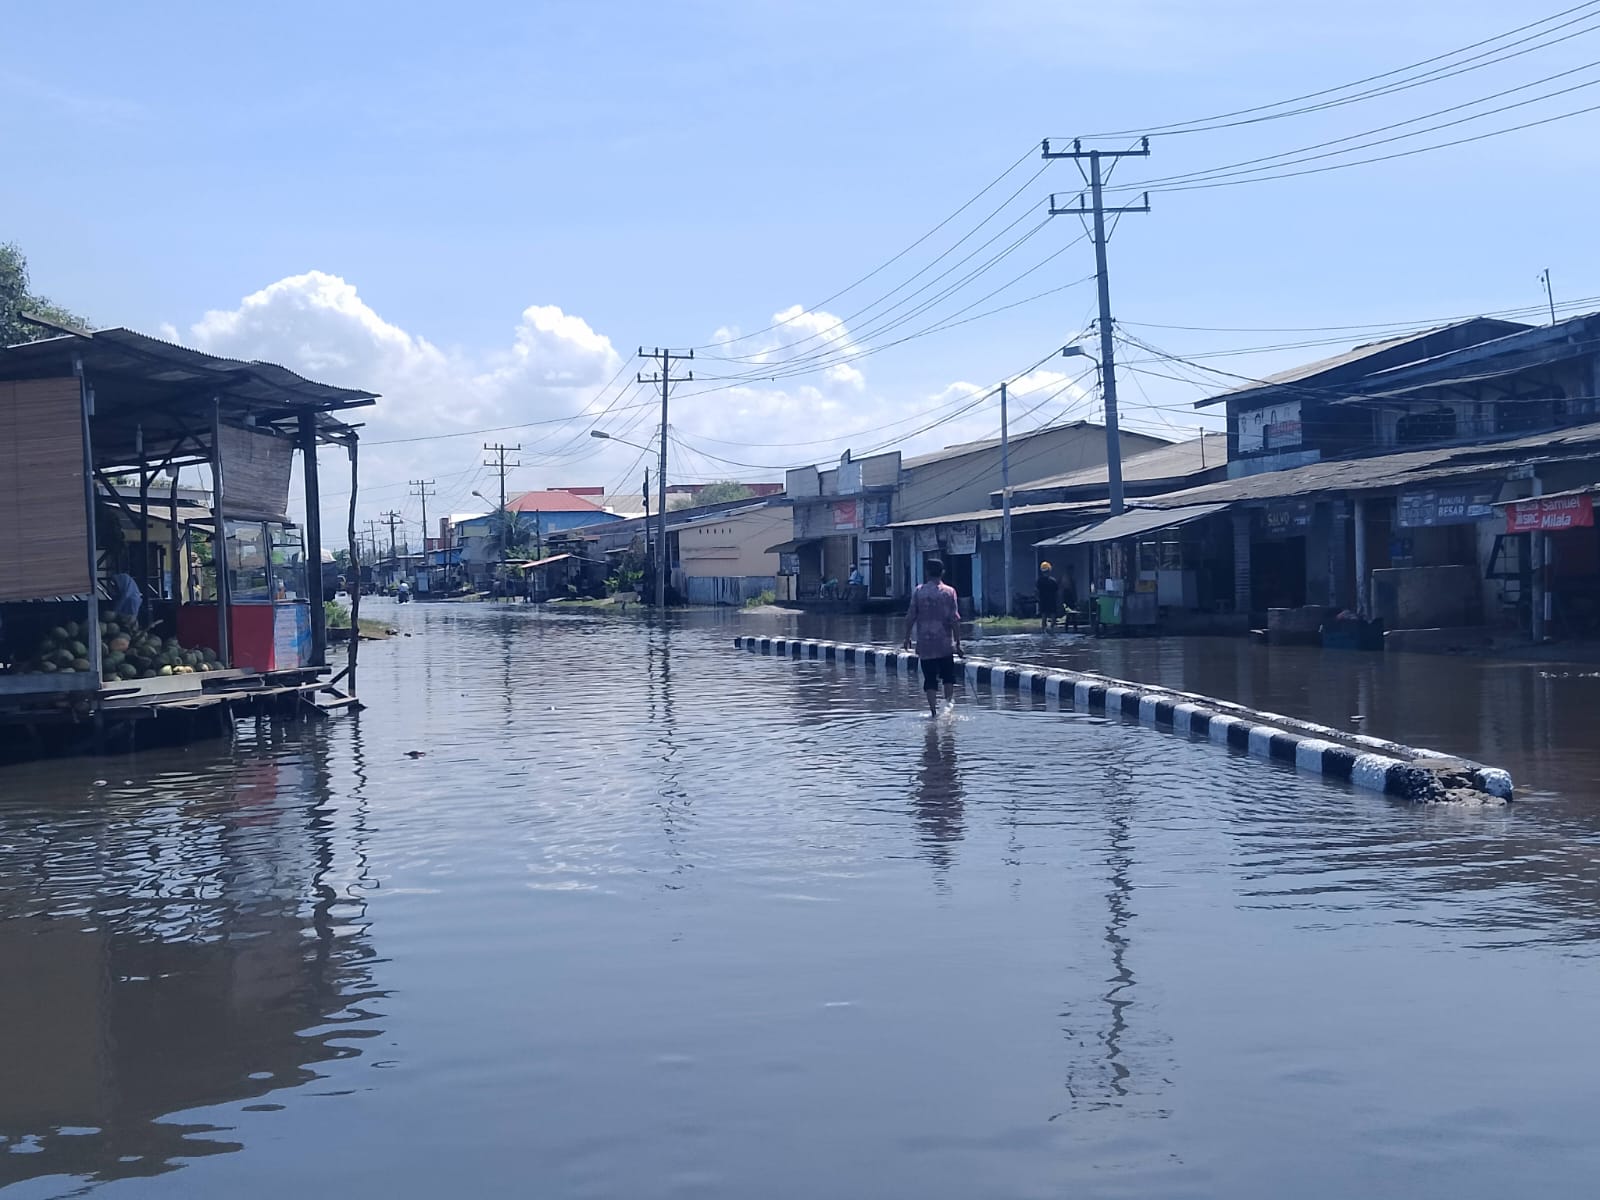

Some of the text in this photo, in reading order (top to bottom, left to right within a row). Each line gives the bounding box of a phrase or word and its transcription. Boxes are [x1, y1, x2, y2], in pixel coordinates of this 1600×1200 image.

[1438, 505, 1464, 517] BESAR
[1541, 496, 1580, 511] Samuel
[1541, 513, 1572, 528] Milala
